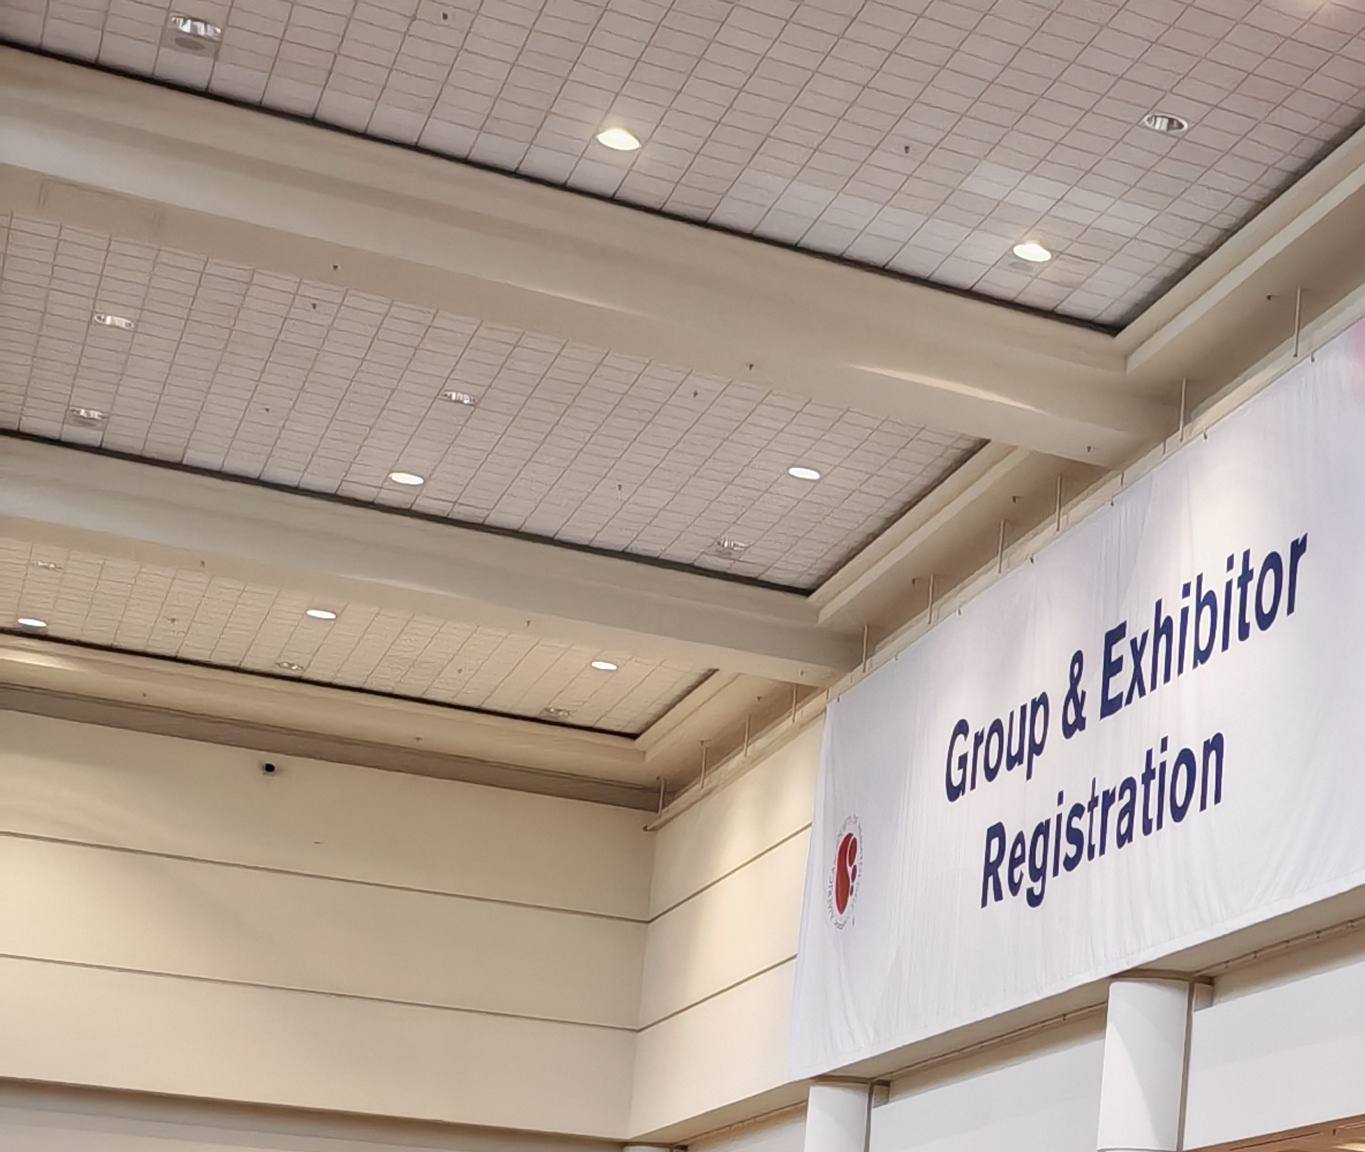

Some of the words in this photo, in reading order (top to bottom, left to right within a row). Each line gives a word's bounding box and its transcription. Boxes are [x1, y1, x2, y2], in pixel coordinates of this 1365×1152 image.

[945, 691, 1050, 802] Group
[1061, 650, 1086, 740] &
[1099, 532, 1308, 720] Exhibitor
[981, 731, 1225, 908] Registration
